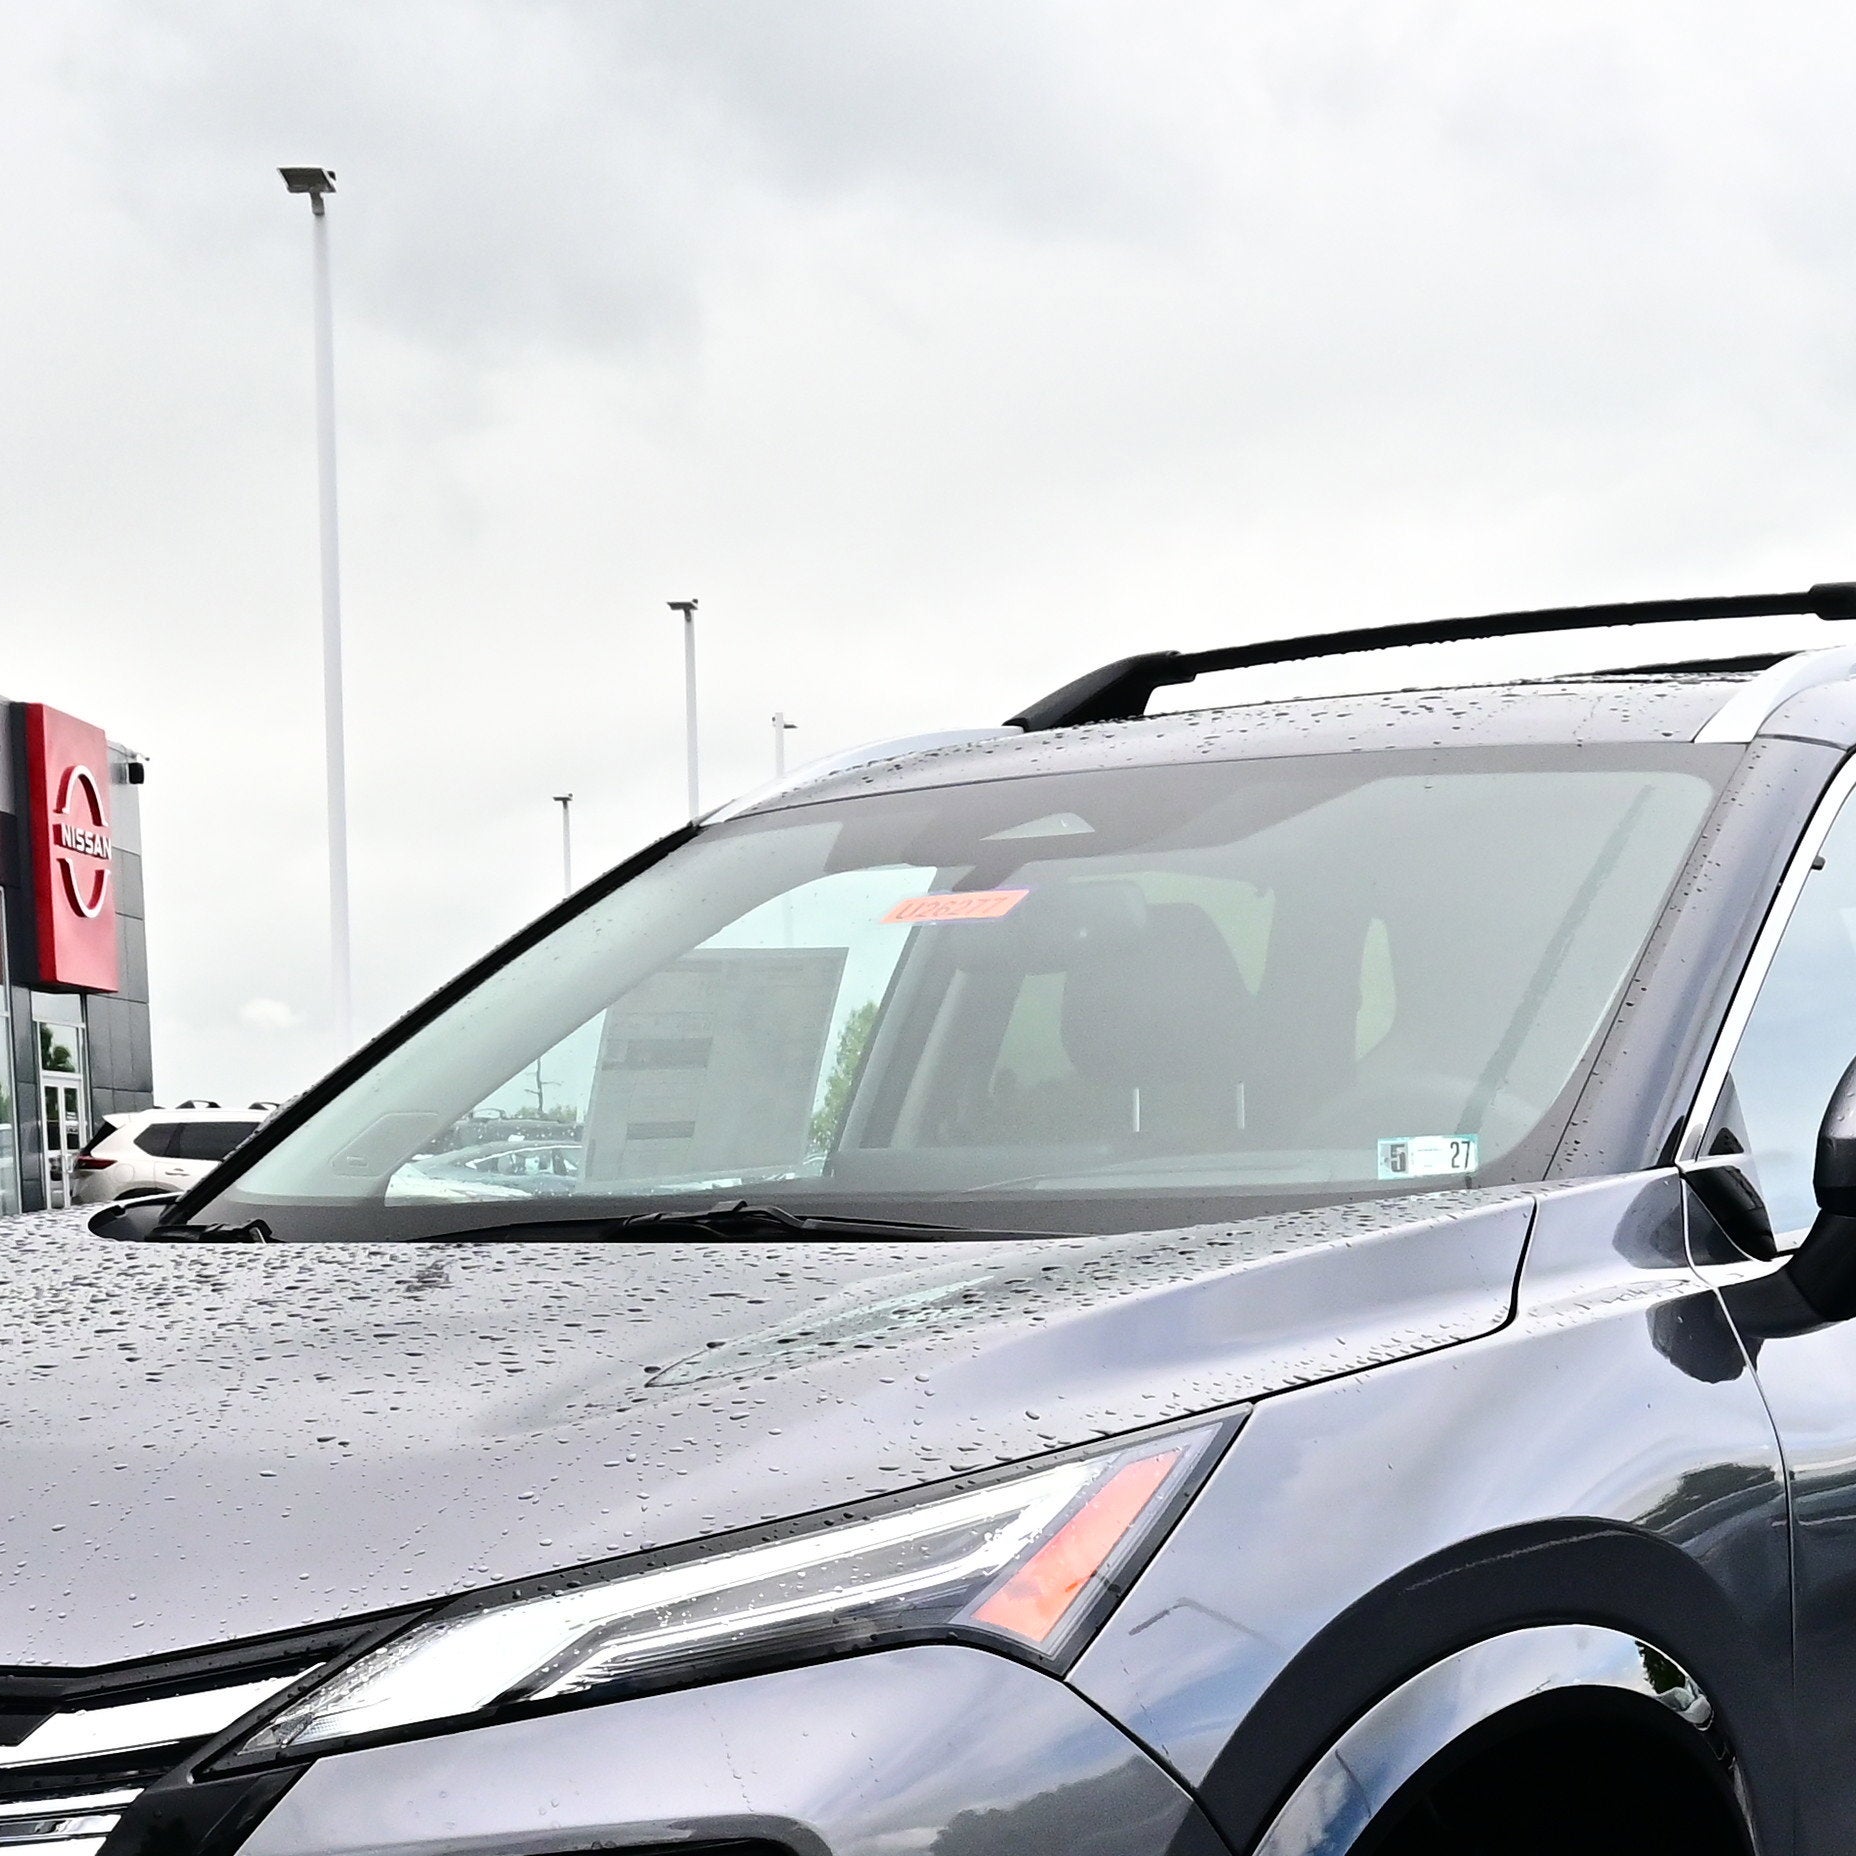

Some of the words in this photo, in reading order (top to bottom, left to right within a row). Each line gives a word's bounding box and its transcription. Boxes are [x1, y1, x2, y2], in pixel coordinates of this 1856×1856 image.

[61, 823, 112, 859] NISSAN
[1390, 1143, 1406, 1173] 5
[1450, 1141, 1471, 1169] 27
